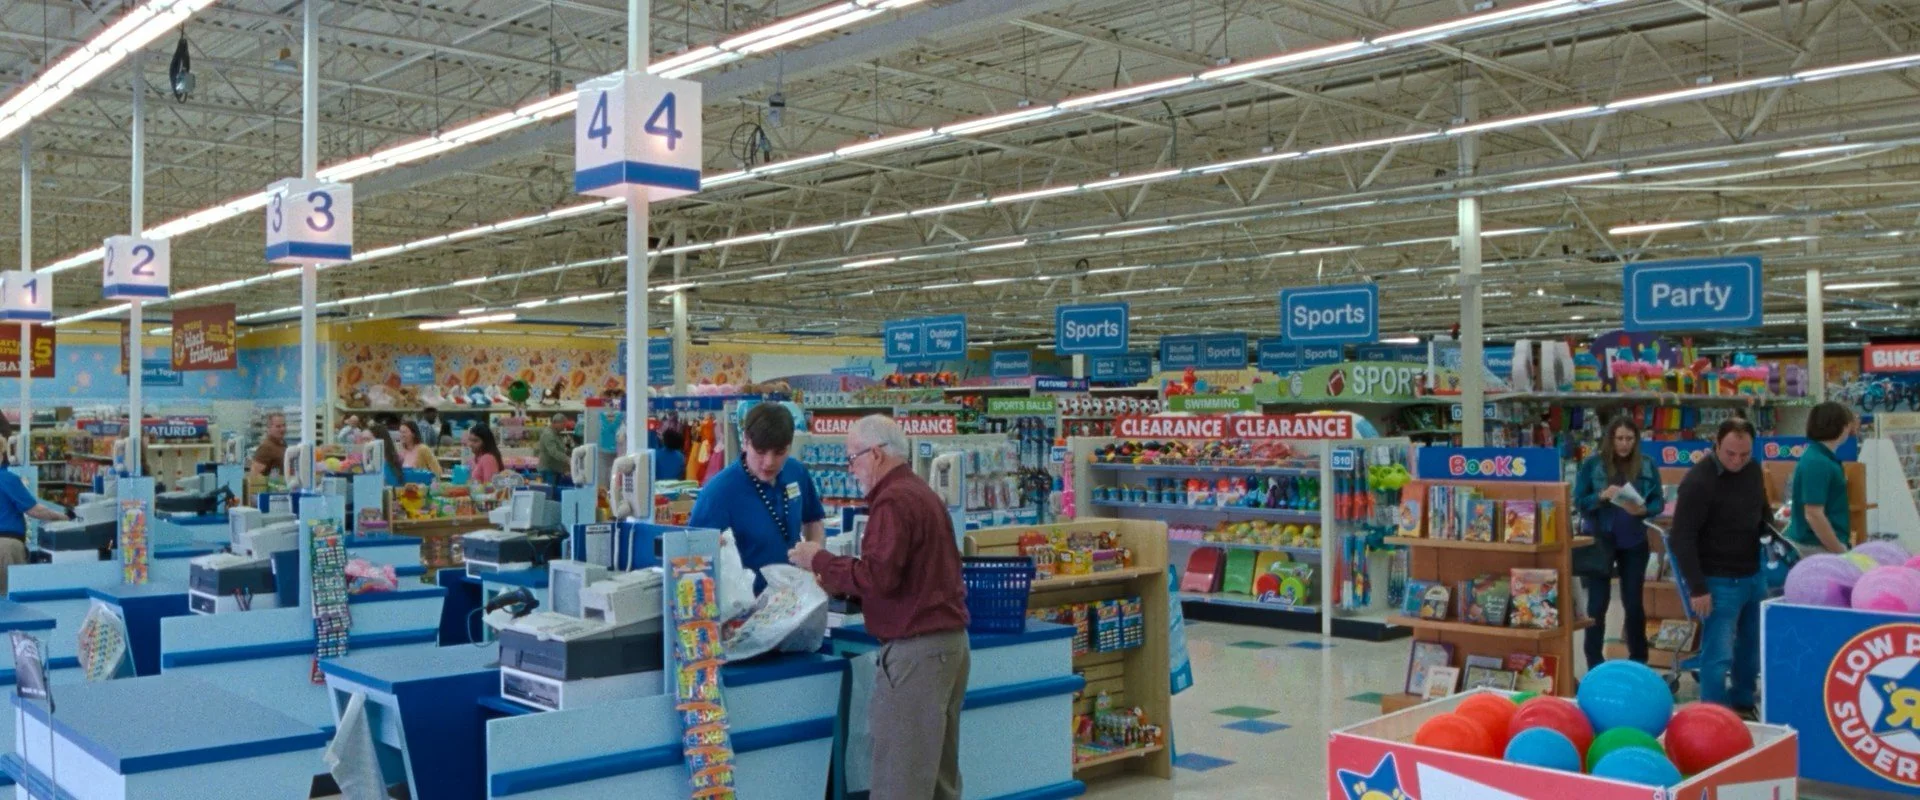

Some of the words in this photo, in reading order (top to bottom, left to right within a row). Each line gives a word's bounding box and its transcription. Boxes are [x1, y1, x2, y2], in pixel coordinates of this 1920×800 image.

[587, 90, 612, 149] 4
[644, 91, 683, 151] 4
[272, 192, 282, 233] 3
[306, 191, 335, 232] 3
[106, 246, 114, 277] 2
[131, 245, 155, 276] 2
[22, 278, 37, 304] 1
[1651, 281, 1732, 311] Party
[1065, 319, 1119, 342] Sports
[1293, 303, 1366, 331] Sports
[929, 329, 959, 339] Outdoor
[935, 339, 949, 349] Play
[1207, 347, 1240, 359] Sports
[1304, 349, 1338, 360] Sports
[1353, 365, 1427, 396] SPOR
[993, 401, 1024, 411] SPORTS
[1027, 400, 1053, 410] BALLS
[1184, 398, 1239, 409] SWIMMING
[815, 419, 854, 433] CLEARA
[901, 418, 952, 434] ARANCE
[1121, 419, 1222, 437] CLEARANCE
[1236, 418, 1346, 438] CLEARANCE
[1836, 633, 1894, 686] LOW
[1834, 701, 1919, 780] SUPER
